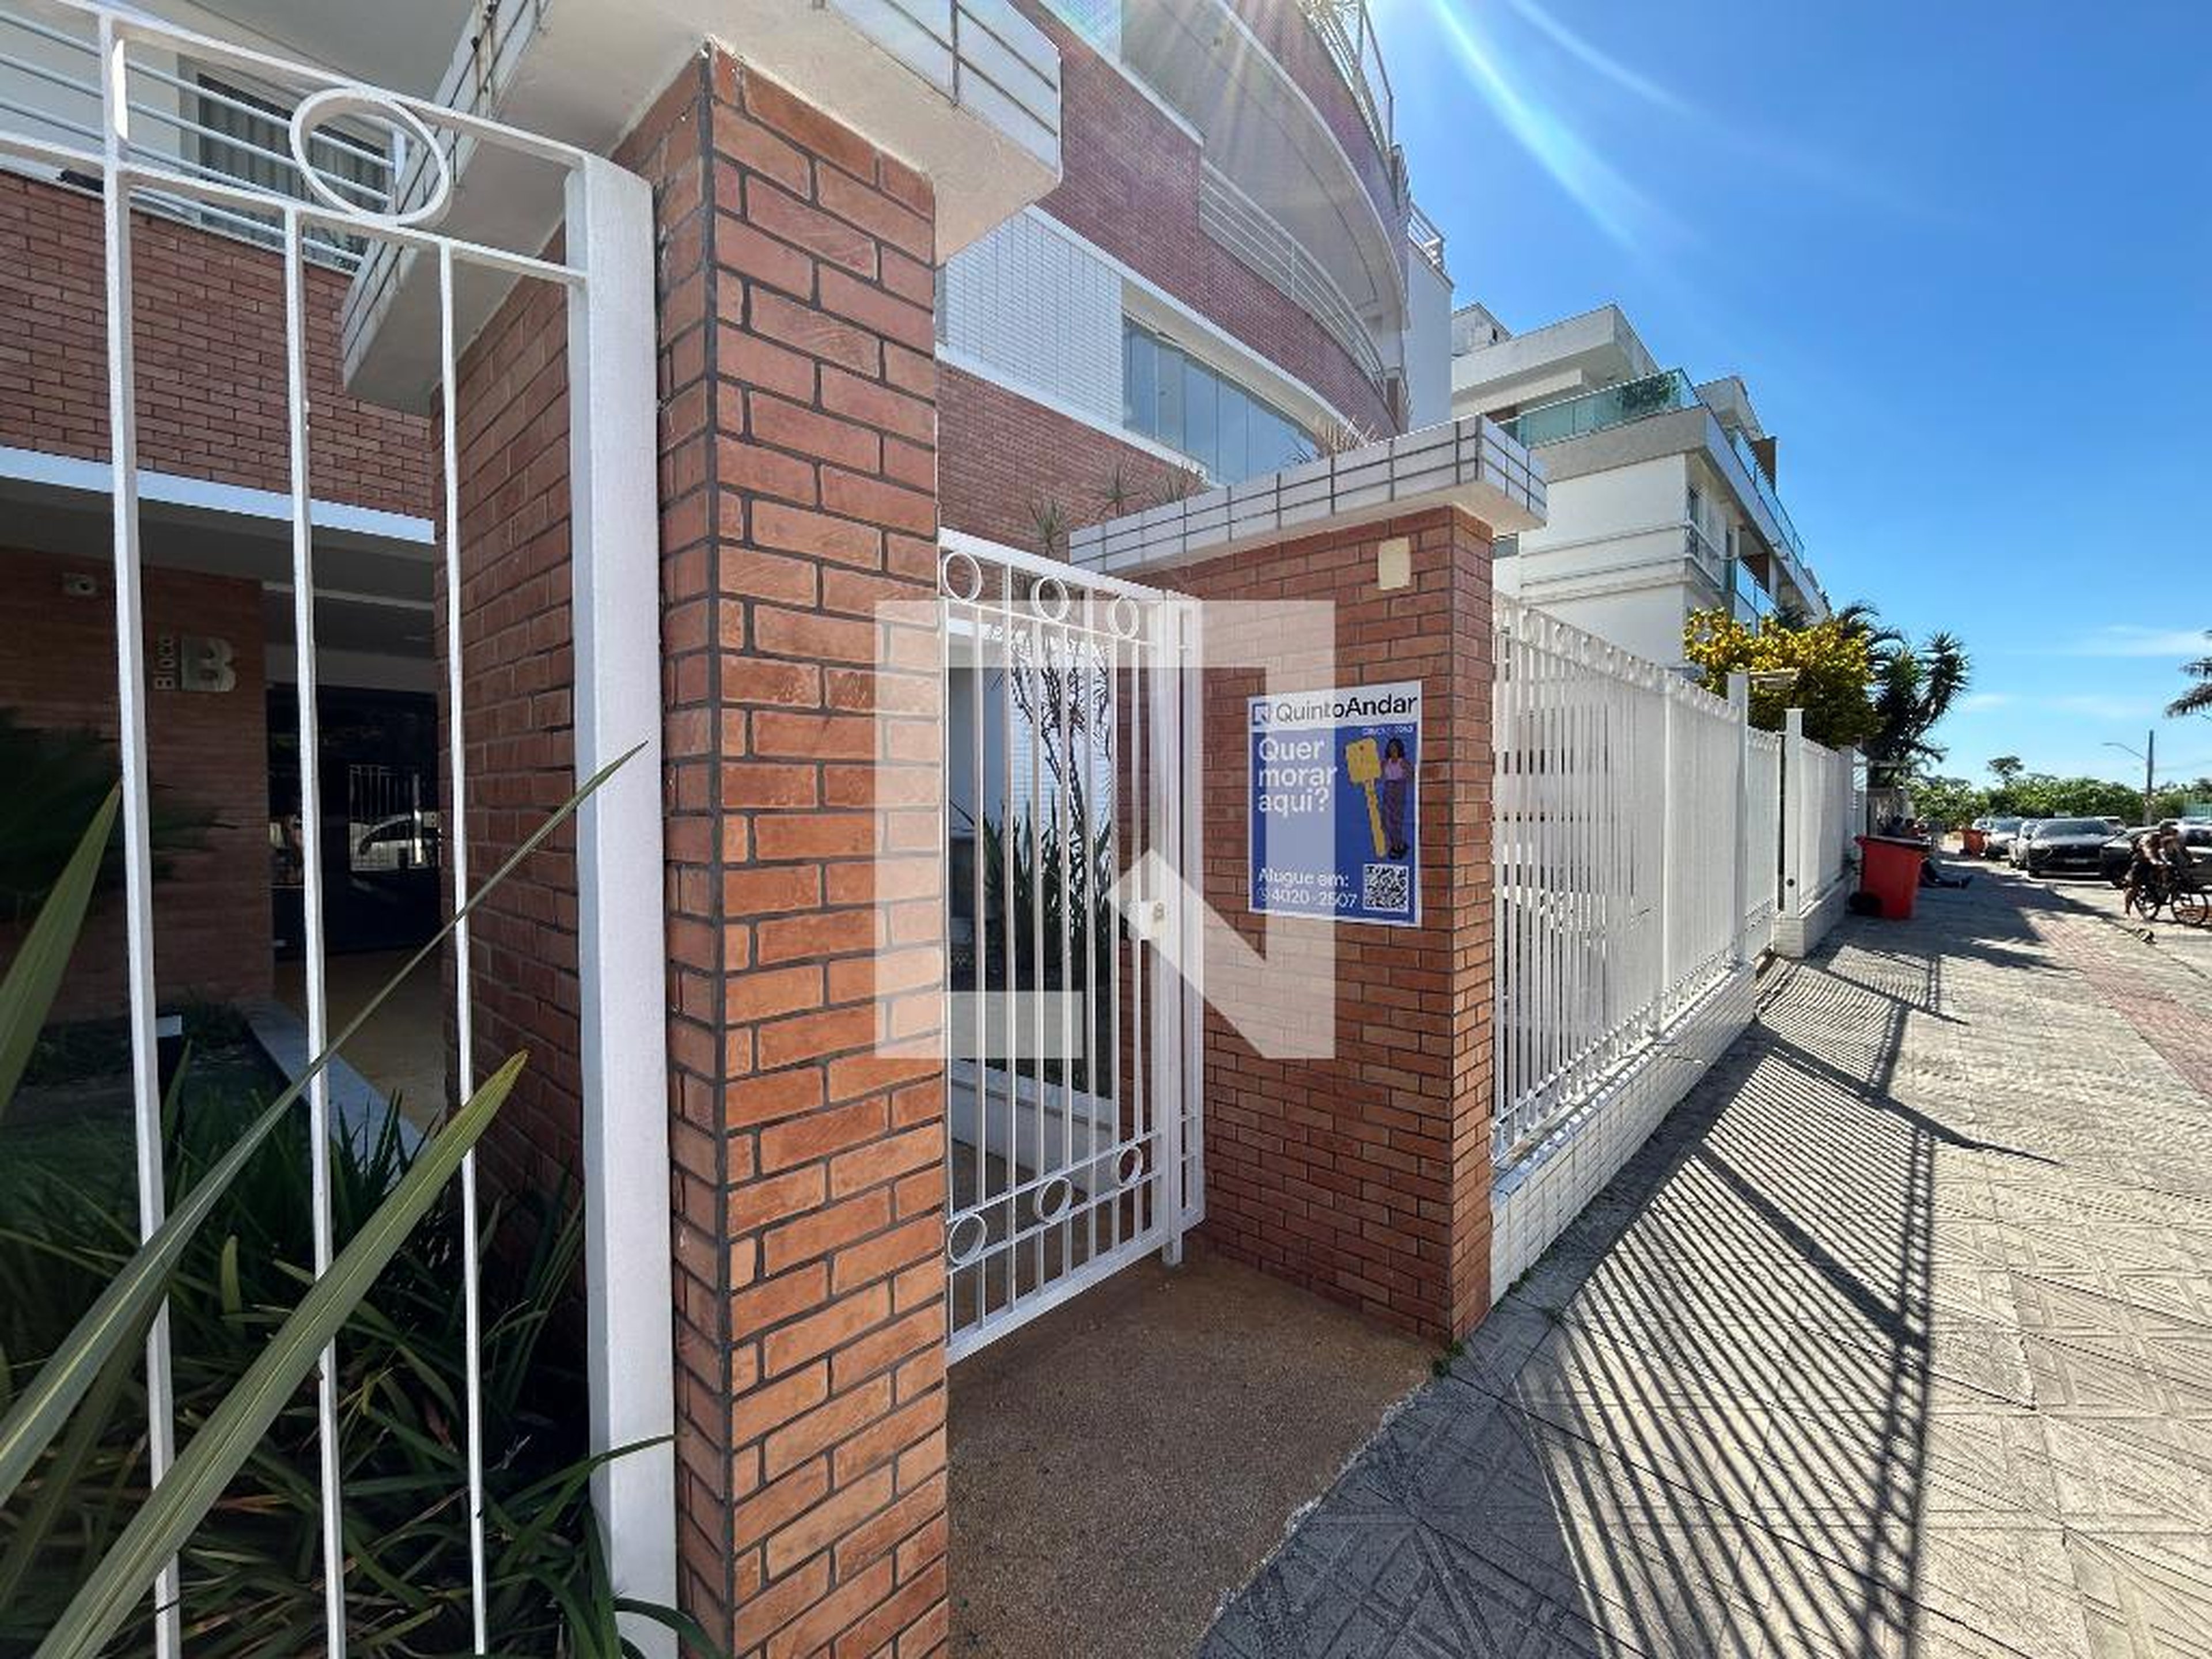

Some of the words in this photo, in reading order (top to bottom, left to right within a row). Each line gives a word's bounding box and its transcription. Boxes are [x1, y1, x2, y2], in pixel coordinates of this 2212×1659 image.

[181, 637, 236, 691] B
[1276, 693, 1418, 722] QuintoAndar
[1258, 737, 1325, 763] Quer
[1258, 767, 1338, 787] morar
[1258, 787, 1330, 818] aqui?
[1258, 868, 1314, 888] Alugue
[1317, 873, 1349, 887] em:
